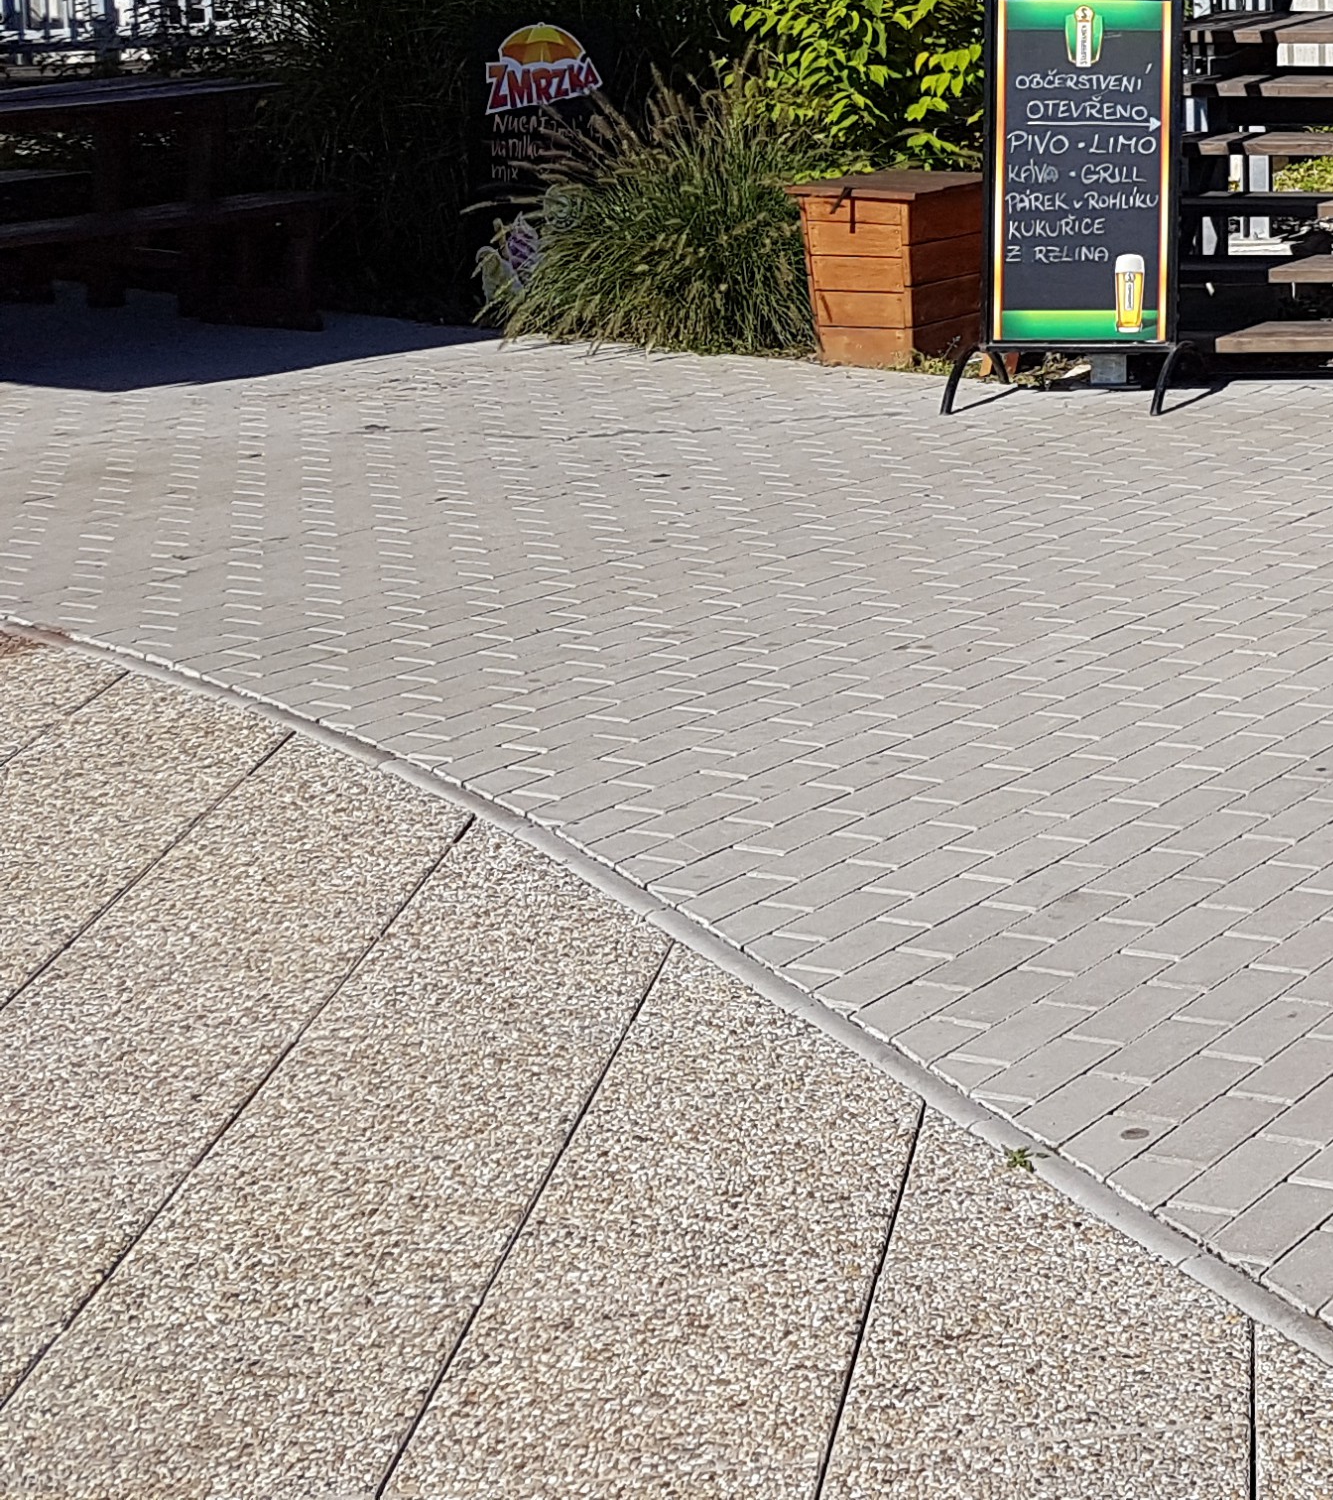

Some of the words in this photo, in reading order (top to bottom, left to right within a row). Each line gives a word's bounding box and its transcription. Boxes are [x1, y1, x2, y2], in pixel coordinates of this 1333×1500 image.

[488, 63, 600, 109] ZMRZKA
[1015, 63, 1153, 92] OBČERSTVENÍ
[1026, 97, 1148, 121] OTEVŘENO
[1006, 130, 1070, 154] PIVO
[1088, 134, 1157, 154] LIMO
[1080, 163, 1148, 184] GRILL
[1005, 189, 1070, 214] PÁREK
[1084, 187, 1160, 211] ROHLÍKU
[1008, 213, 1106, 240] KUKUŘICE
